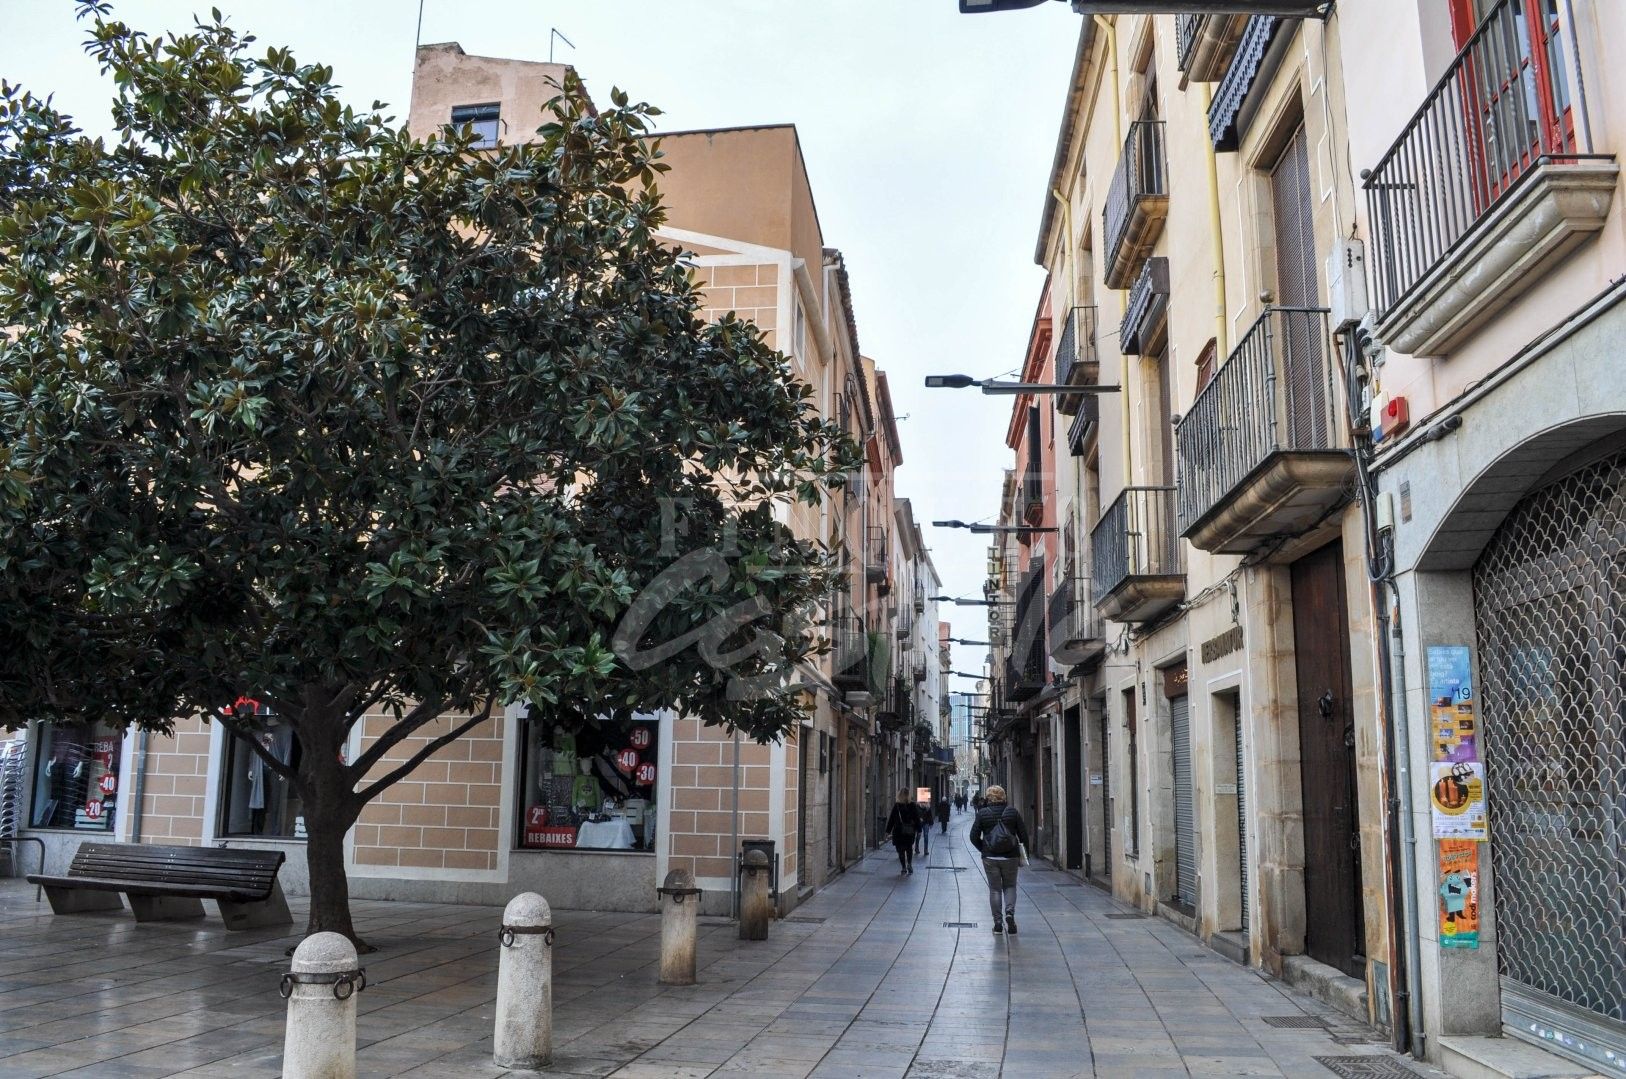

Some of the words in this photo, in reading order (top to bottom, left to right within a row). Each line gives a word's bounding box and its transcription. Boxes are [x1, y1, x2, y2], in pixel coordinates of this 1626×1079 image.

[630, 730, 649, 745] -50
[618, 752, 636, 767] -40
[636, 766, 655, 781] -30
[99, 776, 114, 790] -40
[86, 802, 100, 816] -20
[528, 832, 573, 844] REBAIXES
